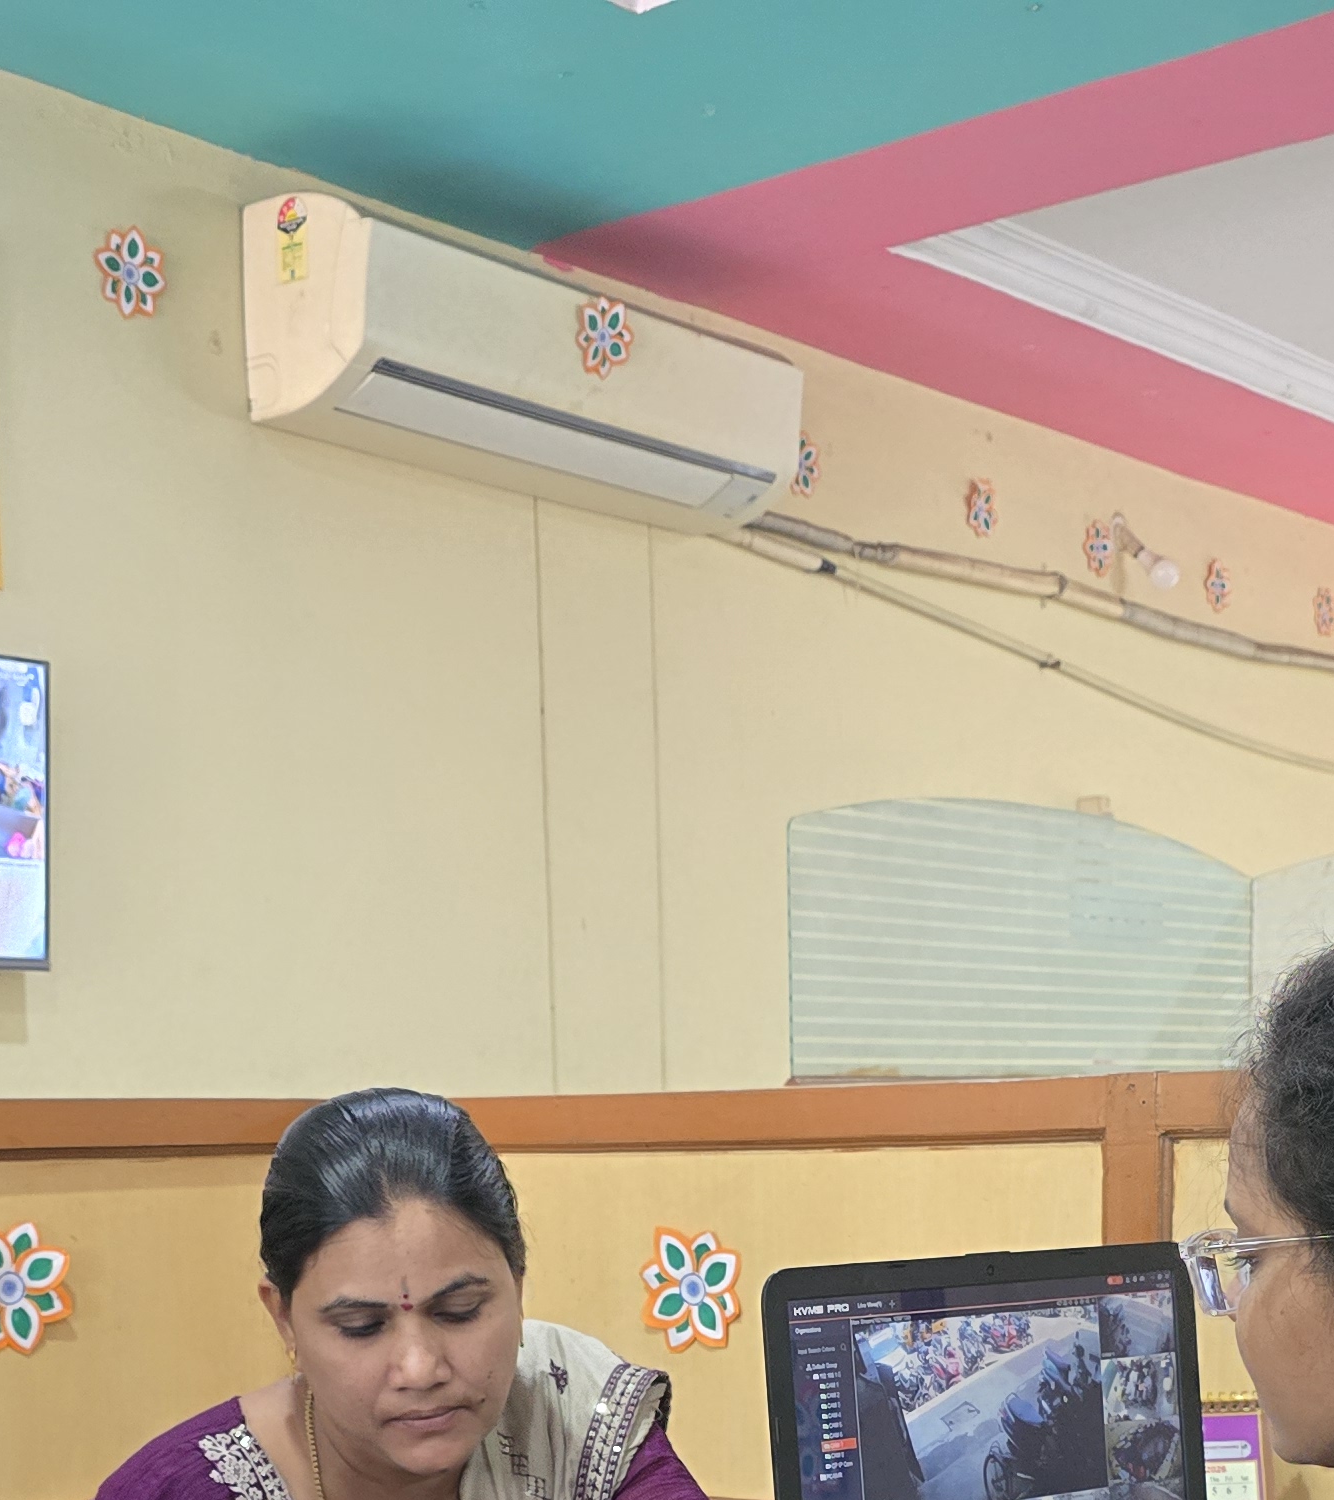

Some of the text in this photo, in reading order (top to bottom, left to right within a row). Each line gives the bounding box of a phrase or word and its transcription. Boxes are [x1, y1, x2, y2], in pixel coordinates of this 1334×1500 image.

[827, 1303, 850, 1314] PRO
[1212, 1485, 1248, 1496] 5 6 7
